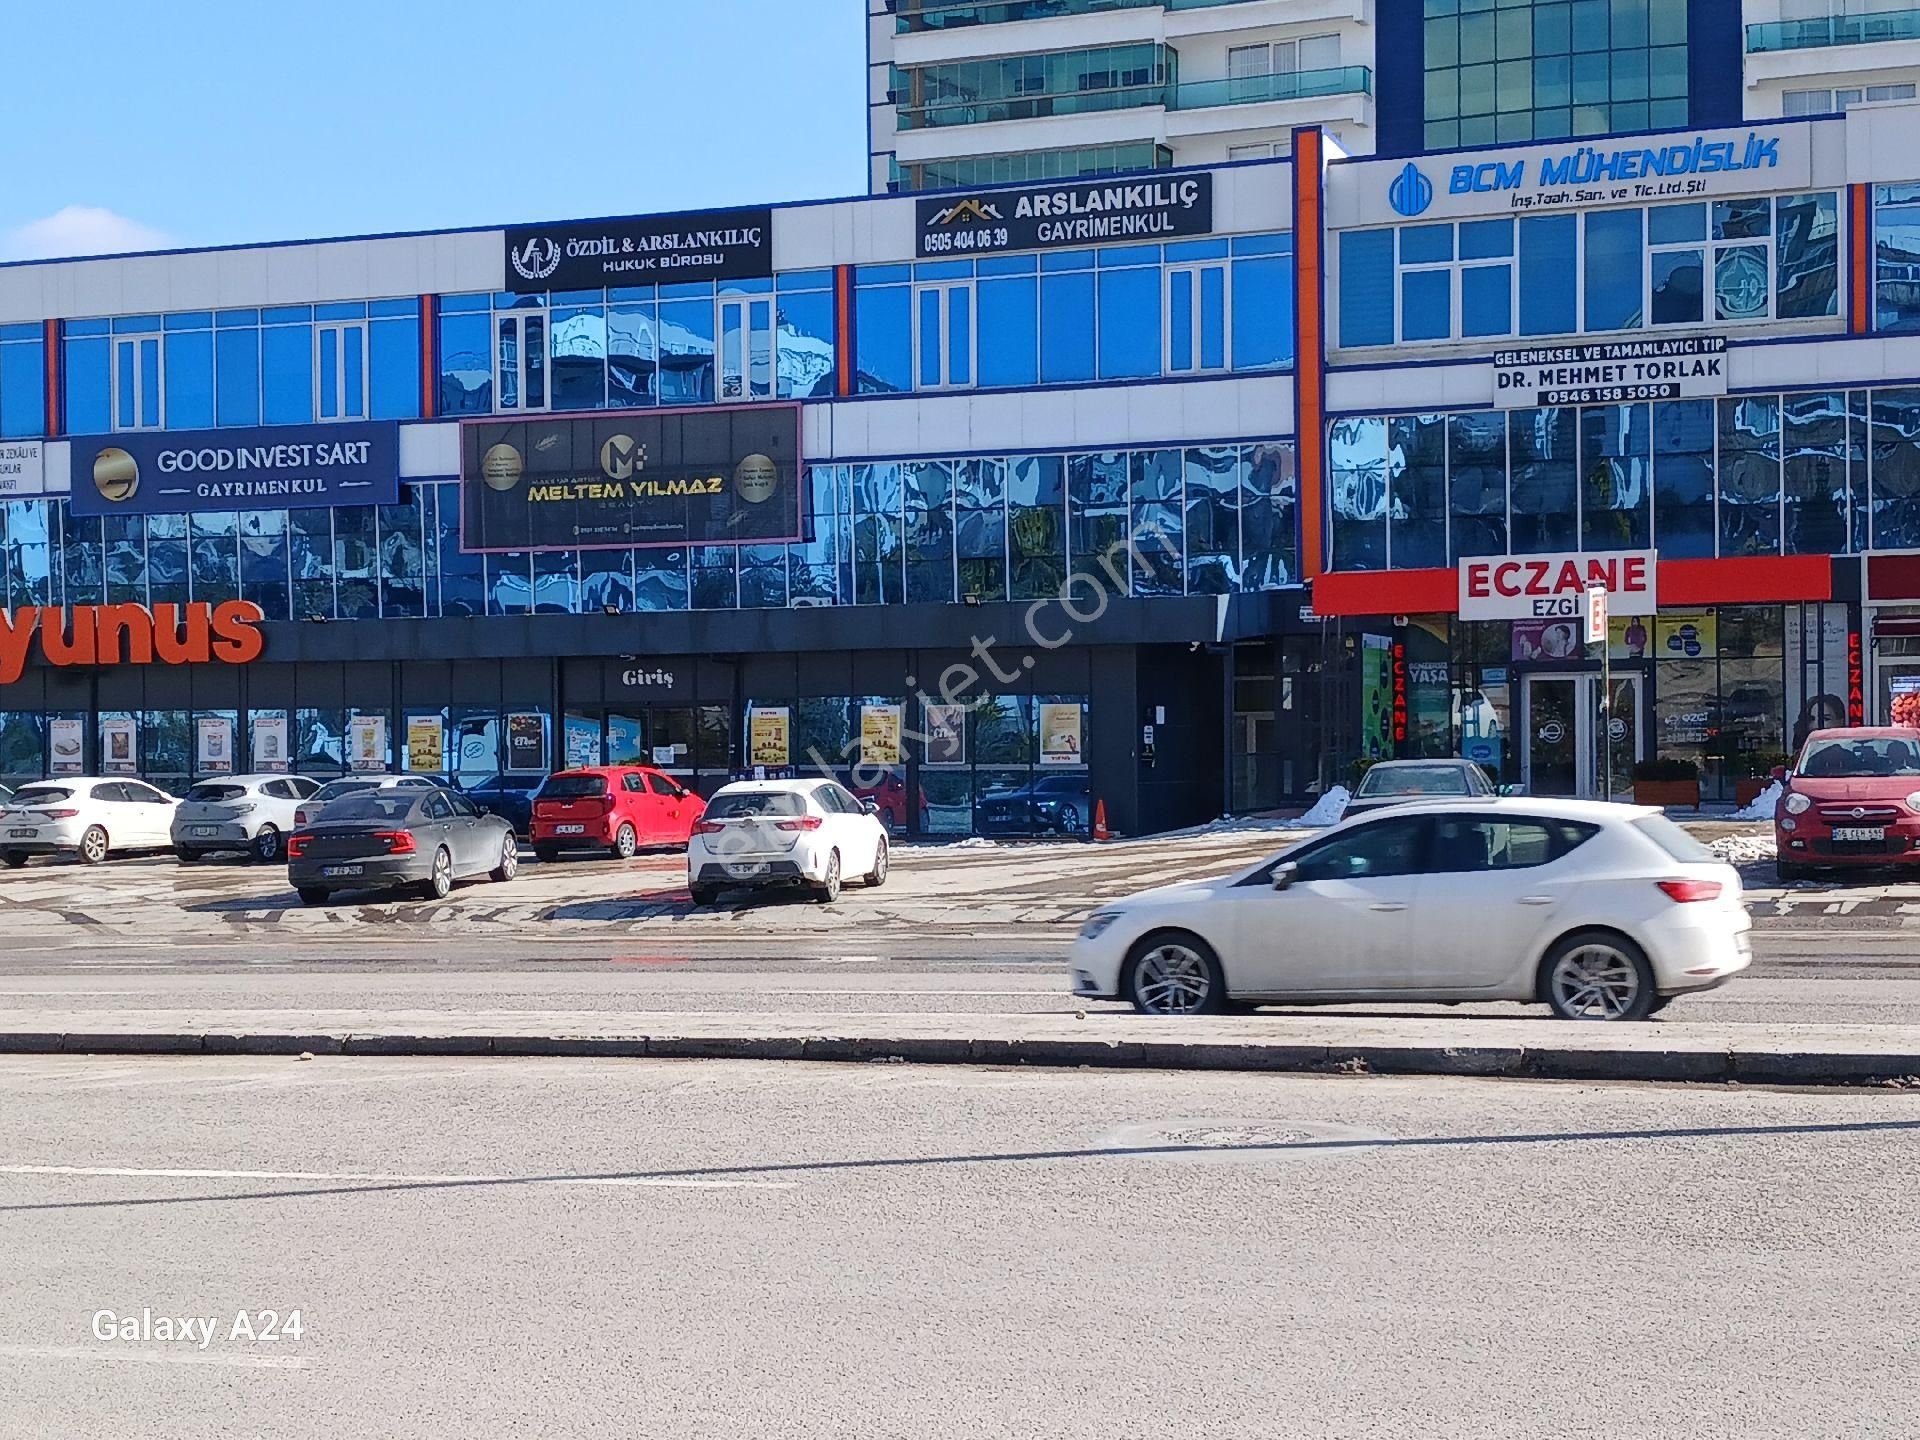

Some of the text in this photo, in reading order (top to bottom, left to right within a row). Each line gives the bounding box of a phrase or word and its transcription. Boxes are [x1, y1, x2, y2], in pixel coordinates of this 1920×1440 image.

[1448, 132, 1780, 195] BCM MÜHENDİSLİK
[1014, 180, 1199, 219] ARSLANKILIÇ
[1611, 188, 1628, 199] ve
[924, 227, 1008, 252] 0505 404 06 39
[1037, 211, 1175, 242] GAYRİMENKUL
[566, 227, 761, 257] ÖZDİL & ARSLANKILIÇ
[602, 253, 724, 273] HUKUK BÜROSU
[1495, 338, 1725, 366] GELENEKSEL VE TAMAMLAYICI TIP
[1497, 358, 1721, 389] DR. MEHMET TORLAK
[1548, 384, 1671, 404] 0546 158 5050
[157, 441, 372, 473] GOOD INVEST SART
[528, 482, 624, 502] MELTEM
[630, 477, 722, 497] YILMAZ
[1468, 556, 1647, 599] ECZANE
[1532, 594, 1579, 616] EZGİ
[622, 668, 674, 689] Giriş
[1409, 669, 1448, 685] YAŞA
